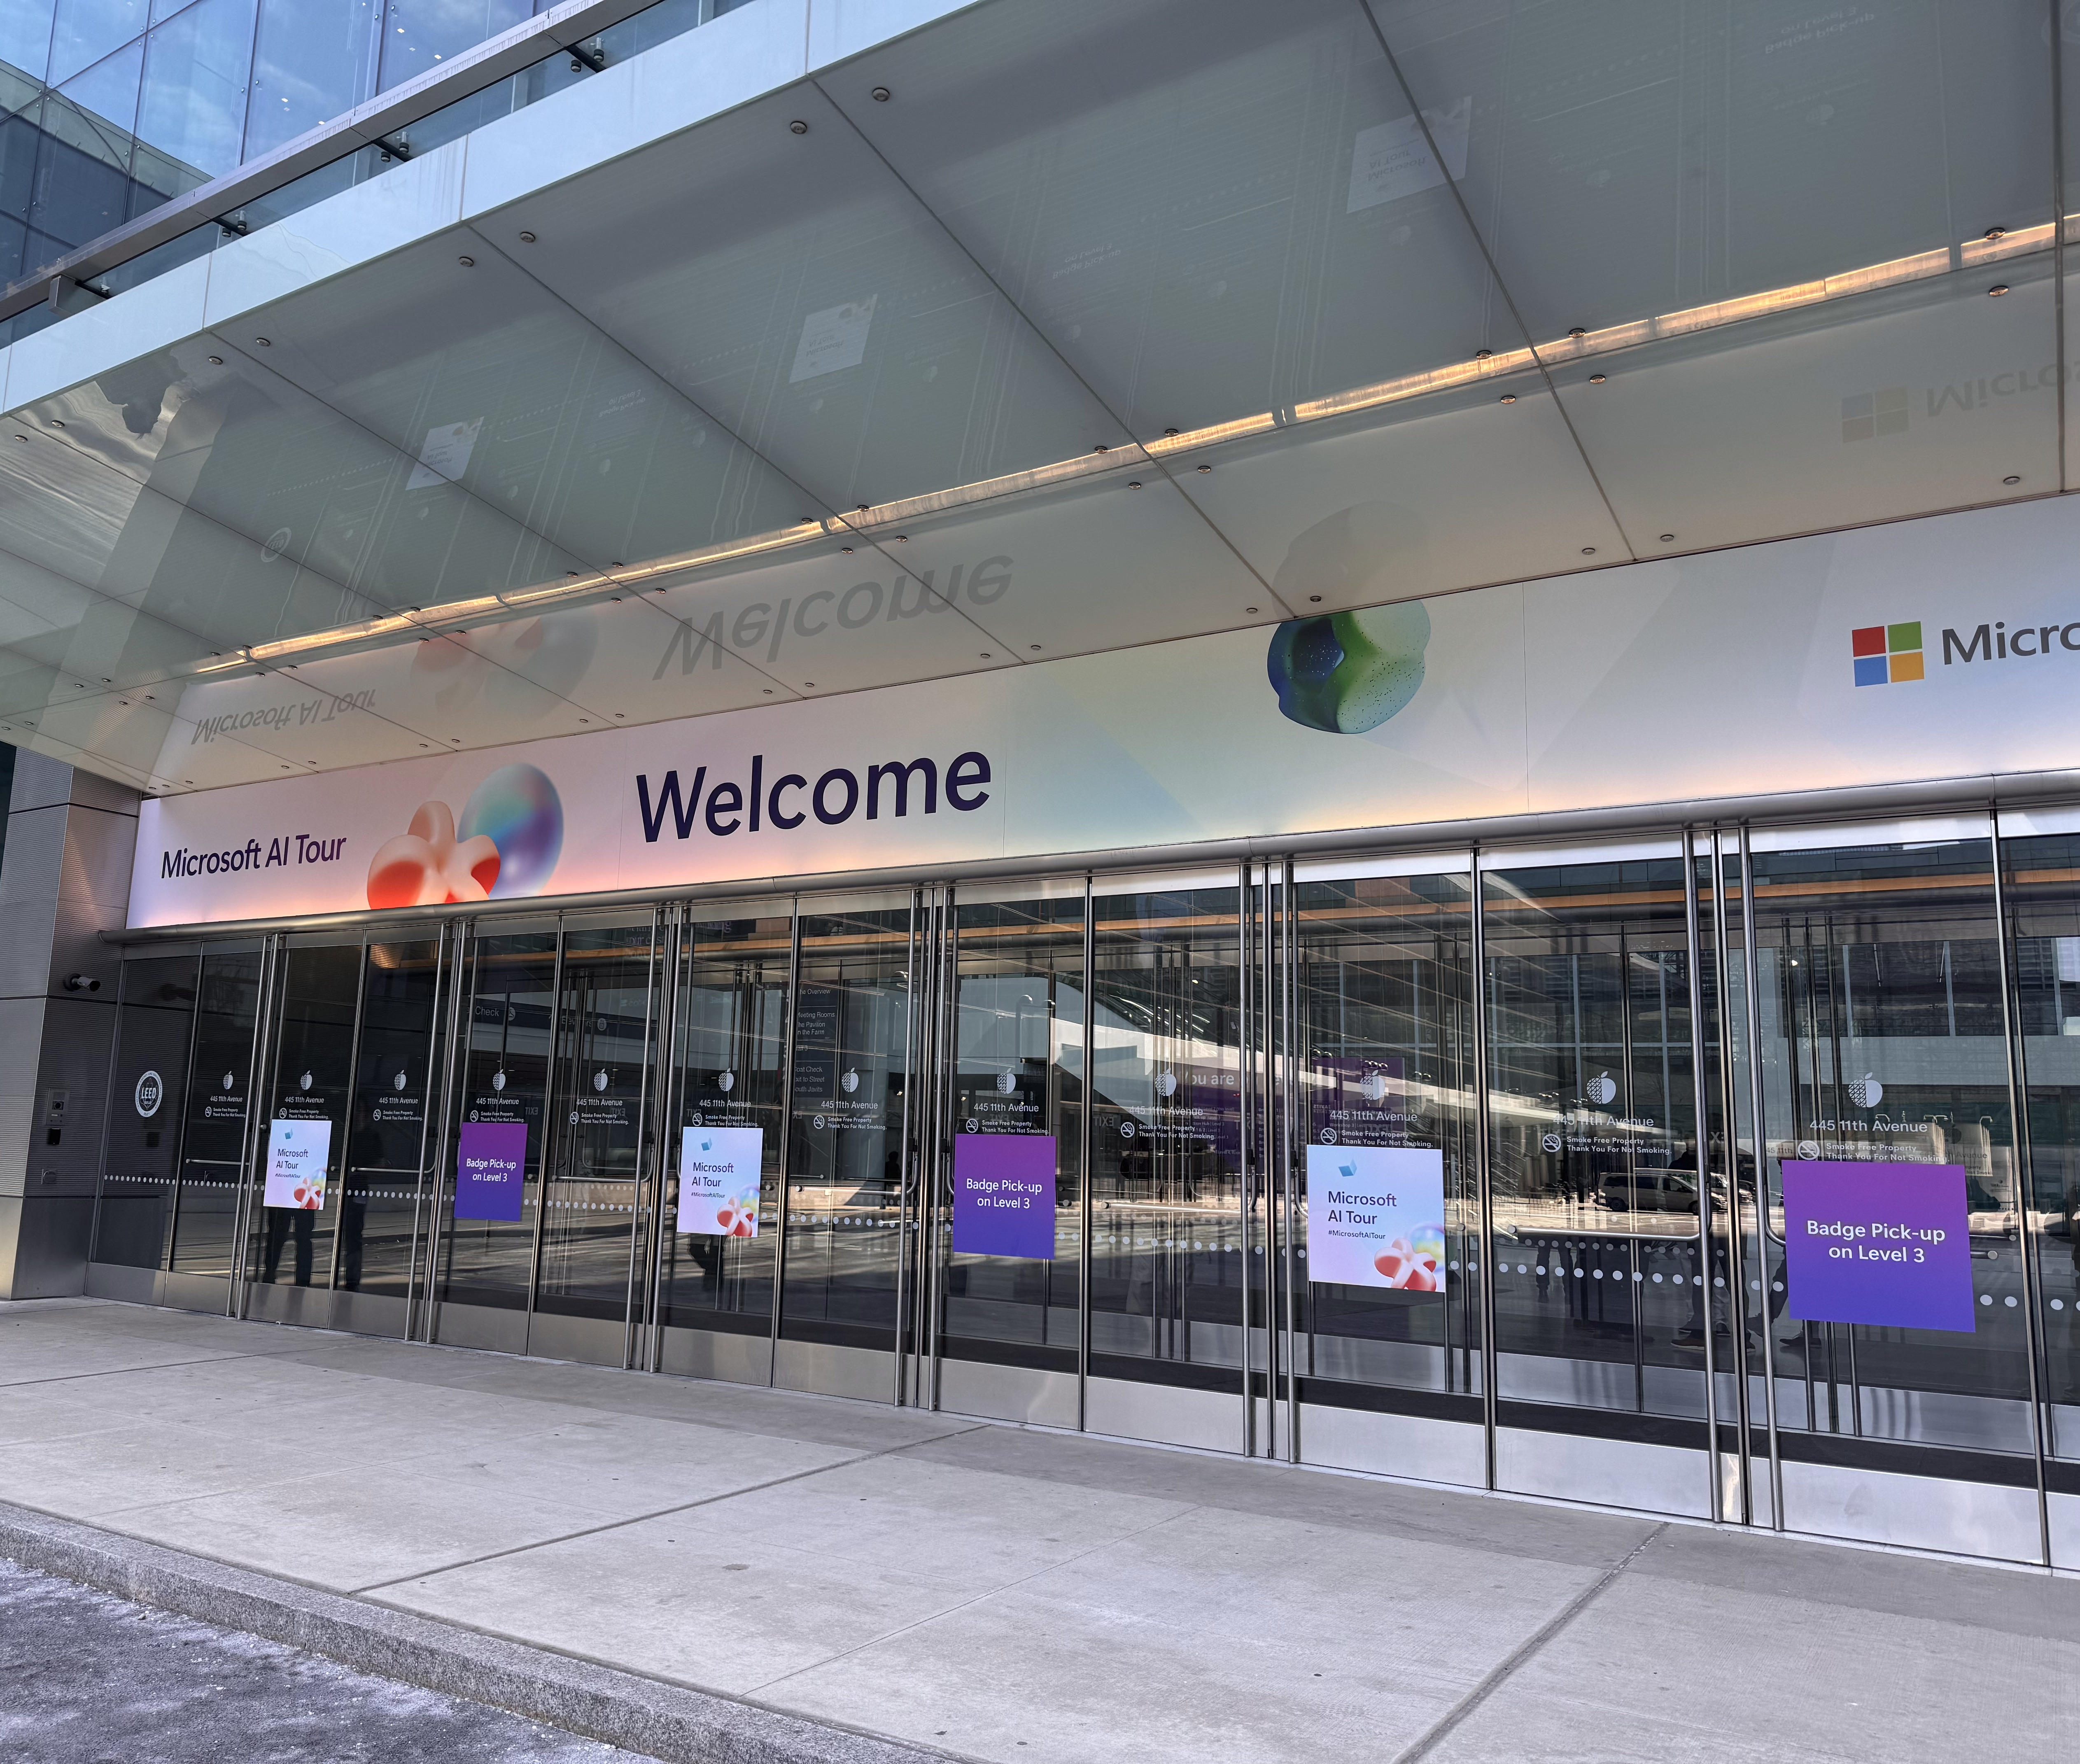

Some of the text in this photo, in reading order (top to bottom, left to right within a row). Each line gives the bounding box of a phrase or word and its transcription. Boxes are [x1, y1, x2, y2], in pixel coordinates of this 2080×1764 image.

[1942, 622, 2080, 665] Micro
[636, 751, 991, 842] Welcome
[161, 834, 347, 878] Microsoft AI Tour
[475, 1006, 499, 1016] Check
[1211, 1075, 1234, 1085] are
[141, 1087, 156, 1099] LEED
[1008, 1104, 1039, 1112] Avenue
[1168, 1107, 1203, 1115] Avenue
[1330, 1111, 1418, 1121] 445 11th Avenue
[1607, 1116, 1654, 1127] Avenue
[1810, 1120, 1928, 1132] 445 11th Avenue
[277, 1149, 308, 1157] Microsoft
[1879, 1144, 1917, 1153] Property
[466, 1158, 516, 1171] Badge Pick-up
[693, 1162, 734, 1173] Microsoft
[483, 1173, 501, 1181] Level
[503, 1173, 507, 1181] 3
[692, 1176, 721, 1187] AI Tour
[966, 1178, 1042, 1195] Badge Pick-up
[977, 1196, 1030, 1209] on Level 3
[1328, 1191, 1397, 1206] Microsoft
[1328, 1210, 1377, 1224] AI Tour
[1328, 1230, 1386, 1239] #MicrosoftAITour
[1807, 1220, 1945, 1245] Badge Pick-up
[1828, 1245, 1925, 1263] on Level 3
